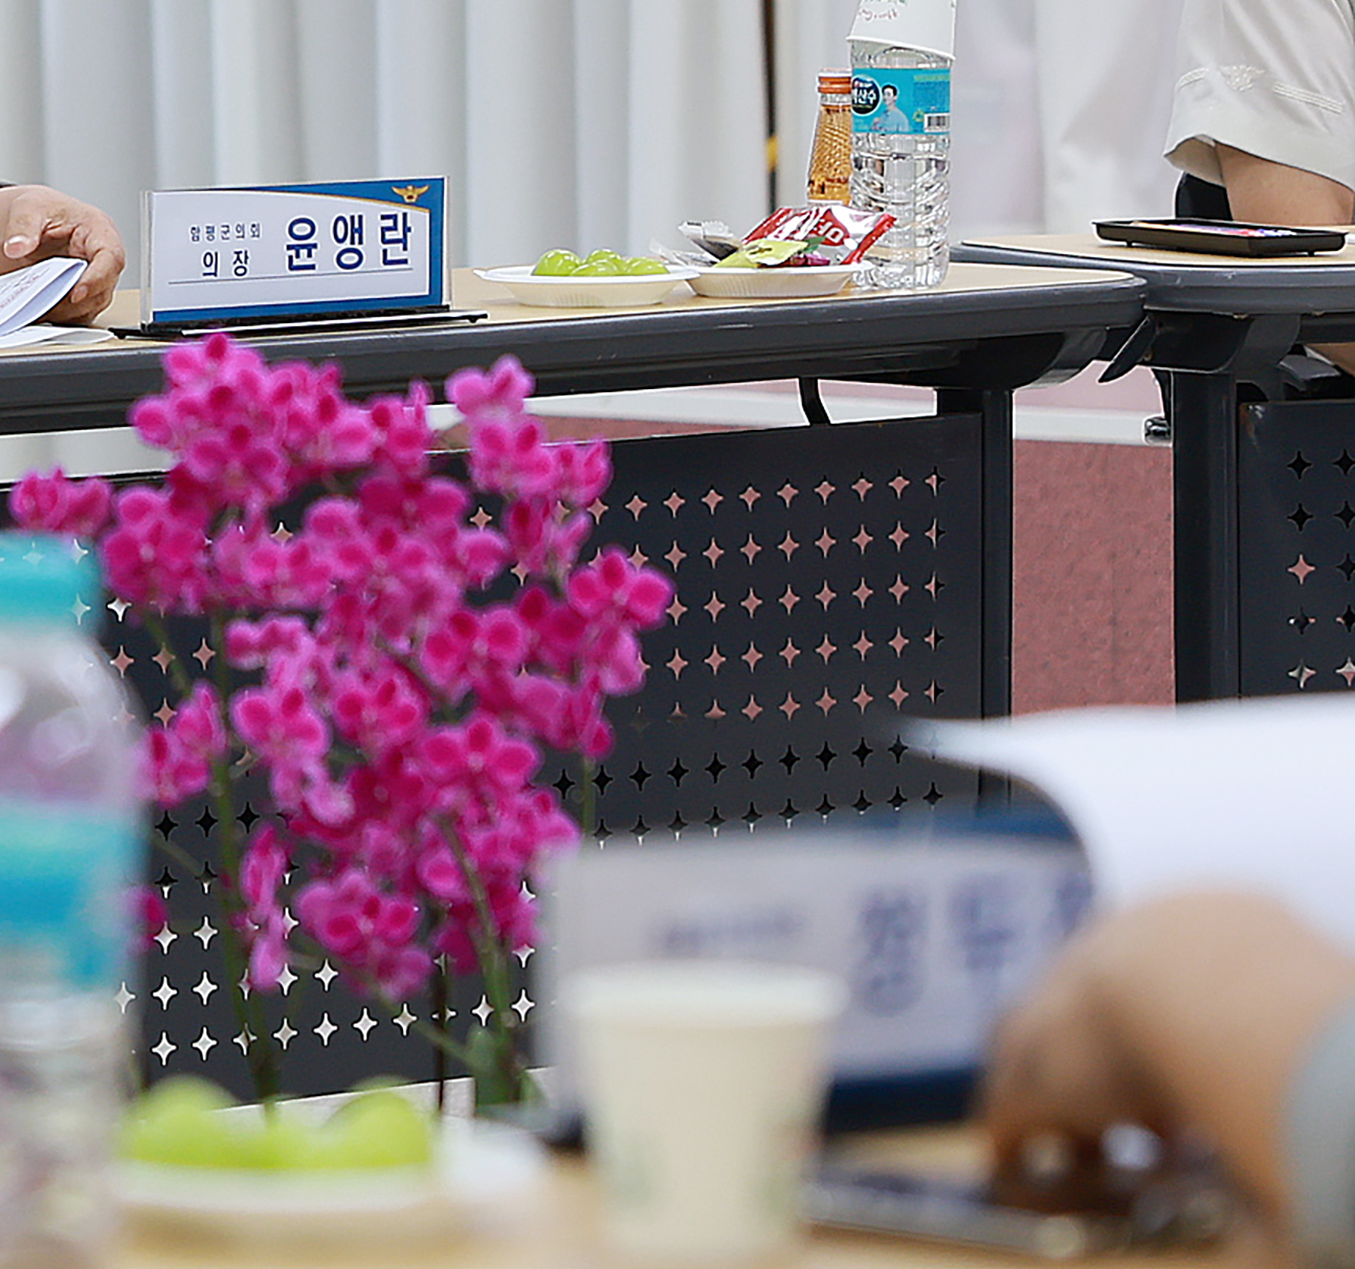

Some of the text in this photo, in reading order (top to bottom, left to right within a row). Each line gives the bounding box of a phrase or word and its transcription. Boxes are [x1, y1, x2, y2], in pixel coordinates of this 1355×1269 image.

[190, 222, 261, 242] 함평군의회
[286, 212, 412, 272] 윤앵란
[202, 250, 249, 278] 의장
